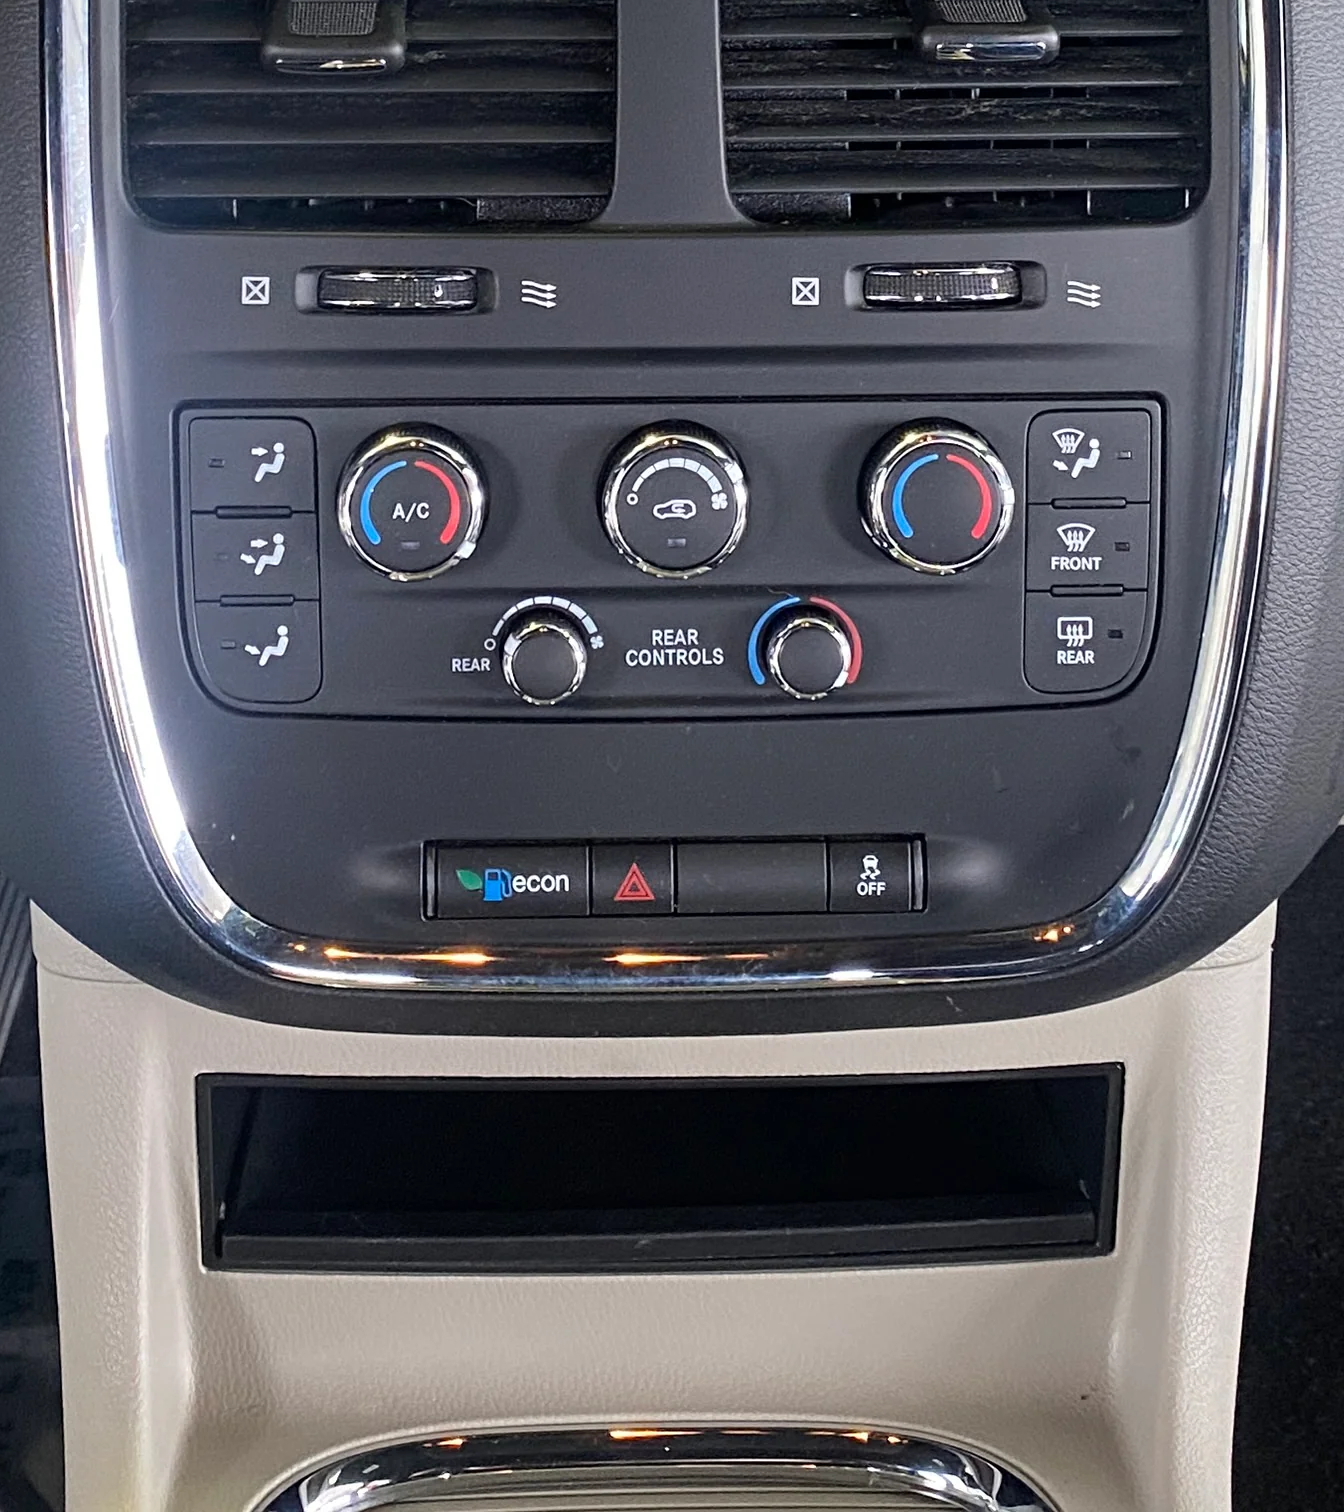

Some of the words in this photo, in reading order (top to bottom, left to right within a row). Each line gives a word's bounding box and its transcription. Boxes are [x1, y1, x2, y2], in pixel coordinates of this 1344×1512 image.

[392, 502, 430, 521] A/C
[1050, 556, 1103, 571] FRONT
[652, 628, 699, 645] REAR
[451, 657, 491, 672] REAR
[625, 647, 724, 667] CONTROLS
[1056, 650, 1095, 665] REAR
[512, 873, 570, 894] econ
[856, 882, 887, 897] OFF
